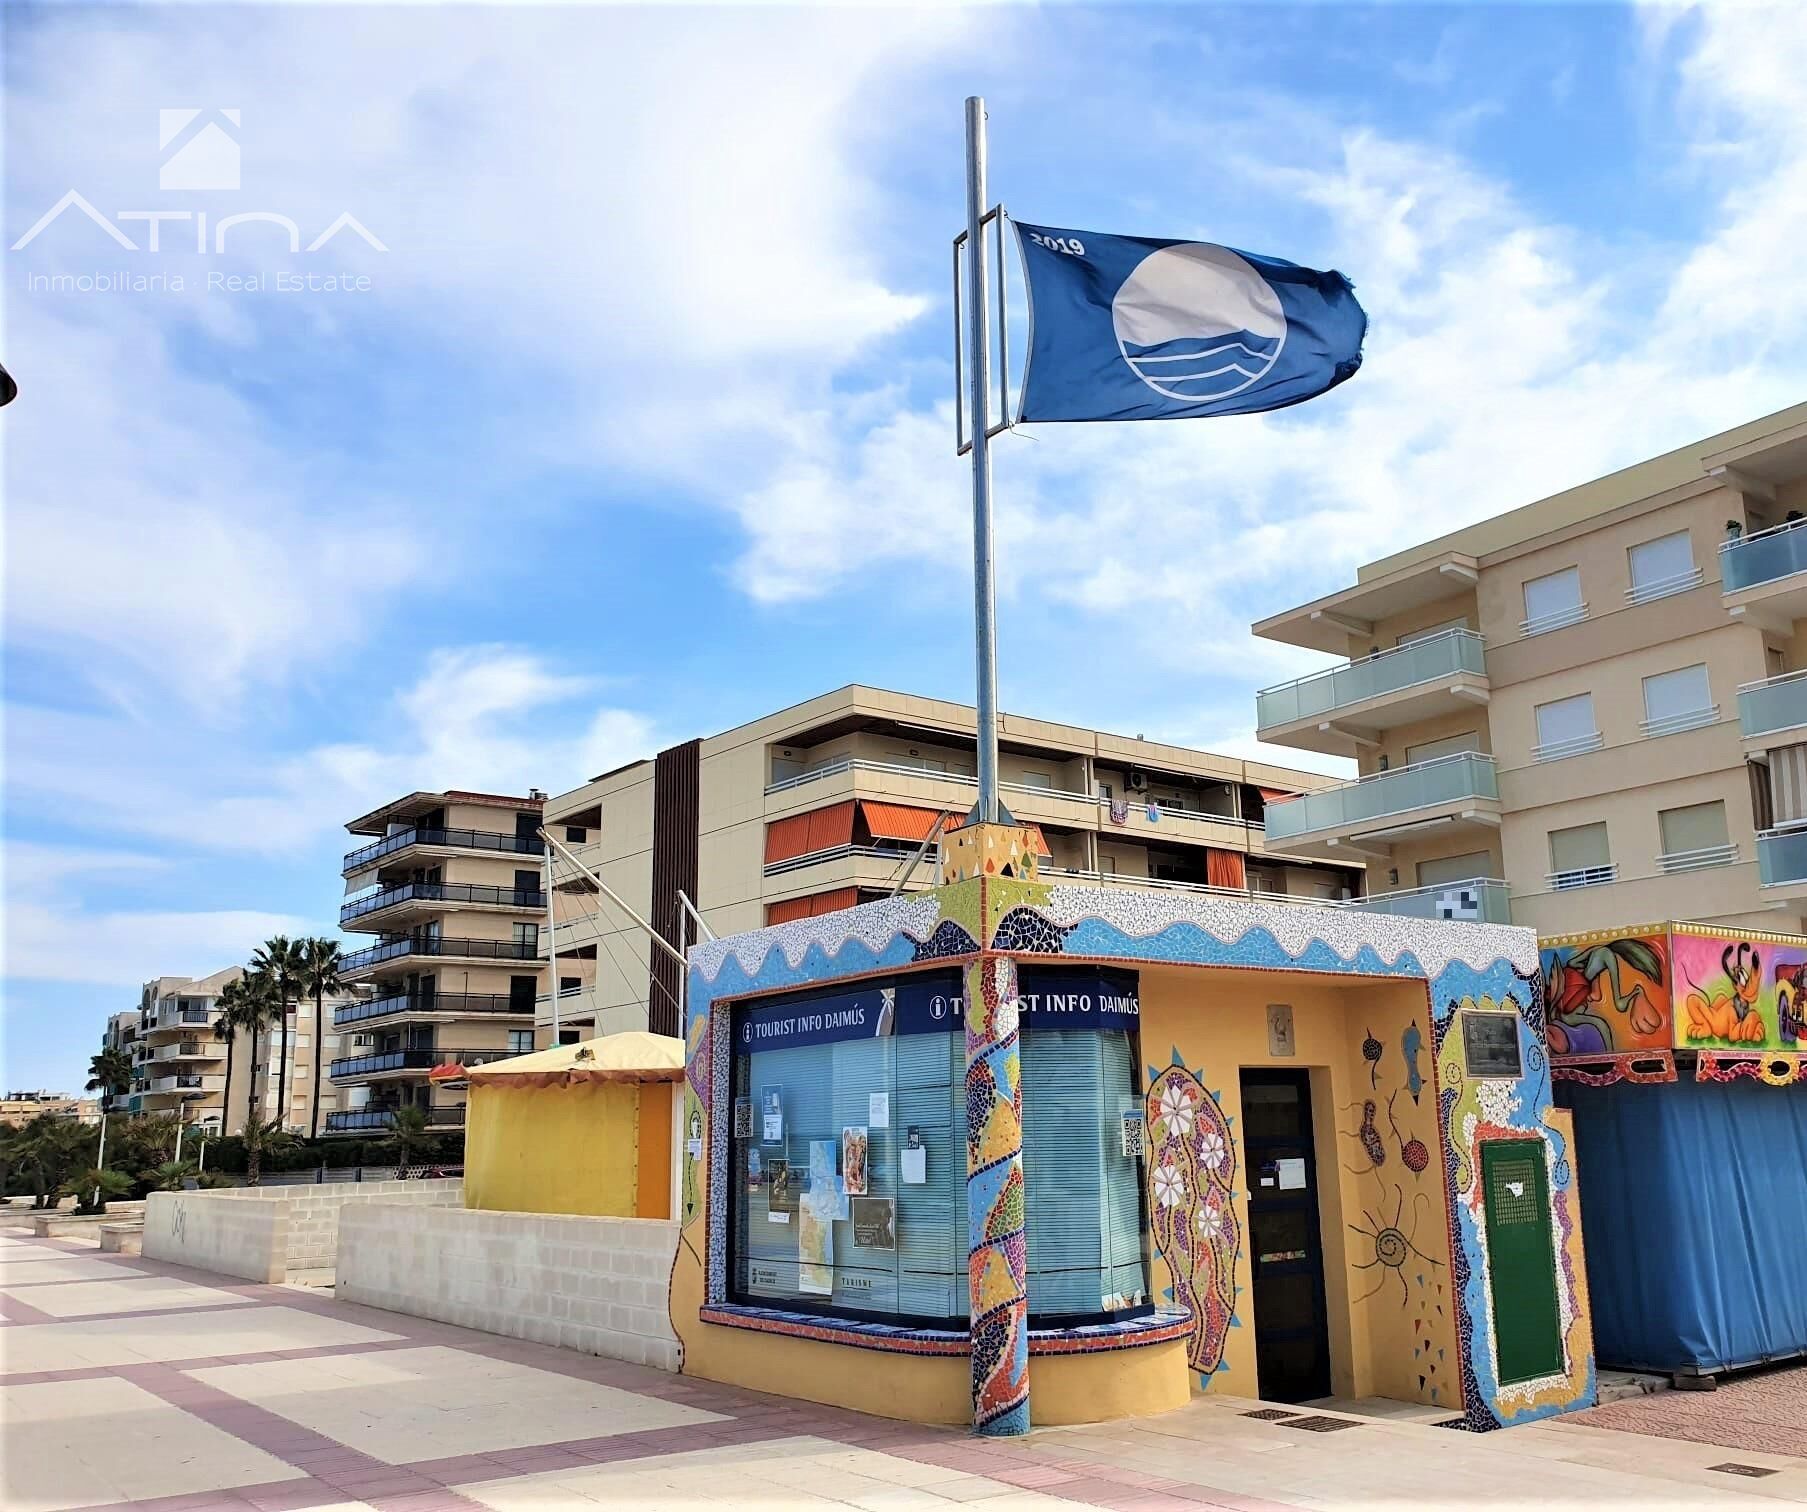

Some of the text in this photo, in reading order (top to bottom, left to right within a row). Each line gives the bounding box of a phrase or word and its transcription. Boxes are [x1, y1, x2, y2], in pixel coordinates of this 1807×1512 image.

[1029, 232, 1085, 256] 2019
[1046, 994, 1091, 1012] INFO
[1099, 992, 1139, 1015] DAIMÚS
[755, 1003, 865, 1038] TOURIST INFO DAIMÚS
